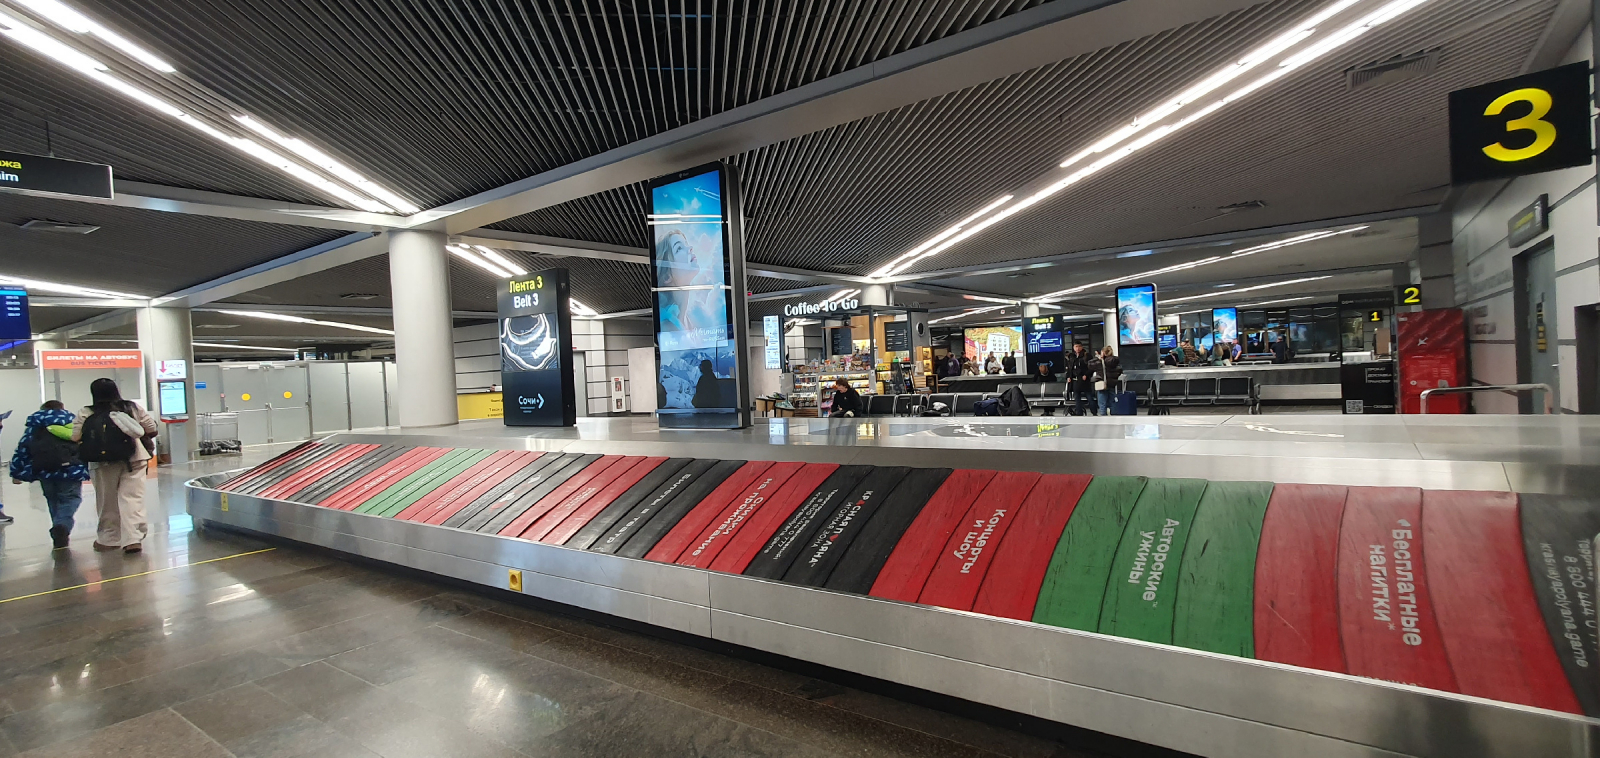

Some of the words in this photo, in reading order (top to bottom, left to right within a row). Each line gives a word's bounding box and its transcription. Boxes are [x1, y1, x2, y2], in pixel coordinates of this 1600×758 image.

[1482, 88, 1557, 162] 3
[509, 280, 536, 294] Лента
[536, 275, 543, 289] 3
[513, 293, 531, 309] Belt
[532, 292, 539, 306] 3
[1404, 287, 1420, 303] 2
[784, 302, 820, 316] Coffee
[822, 299, 838, 312] To
[841, 298, 858, 310] Go
[1371, 311, 1380, 321] 1
[518, 395, 536, 406] Сочи
[757, 478, 773, 490] на
[691, 492, 759, 556] проживание
[722, 496, 764, 535] Скидки
[827, 501, 853, 530] ИГОРНАЯ
[973, 519, 986, 528] и
[778, 536, 789, 547] 777
[811, 530, 830, 548] ЗОНА
[953, 531, 979, 560] шоу
[960, 509, 1007, 574] Концерты
[1127, 530, 1156, 584] ужины
[1563, 555, 1578, 564] 8
[1578, 591, 1595, 616] 444
[1540, 542, 1589, 668] krasnayapolyana.game
